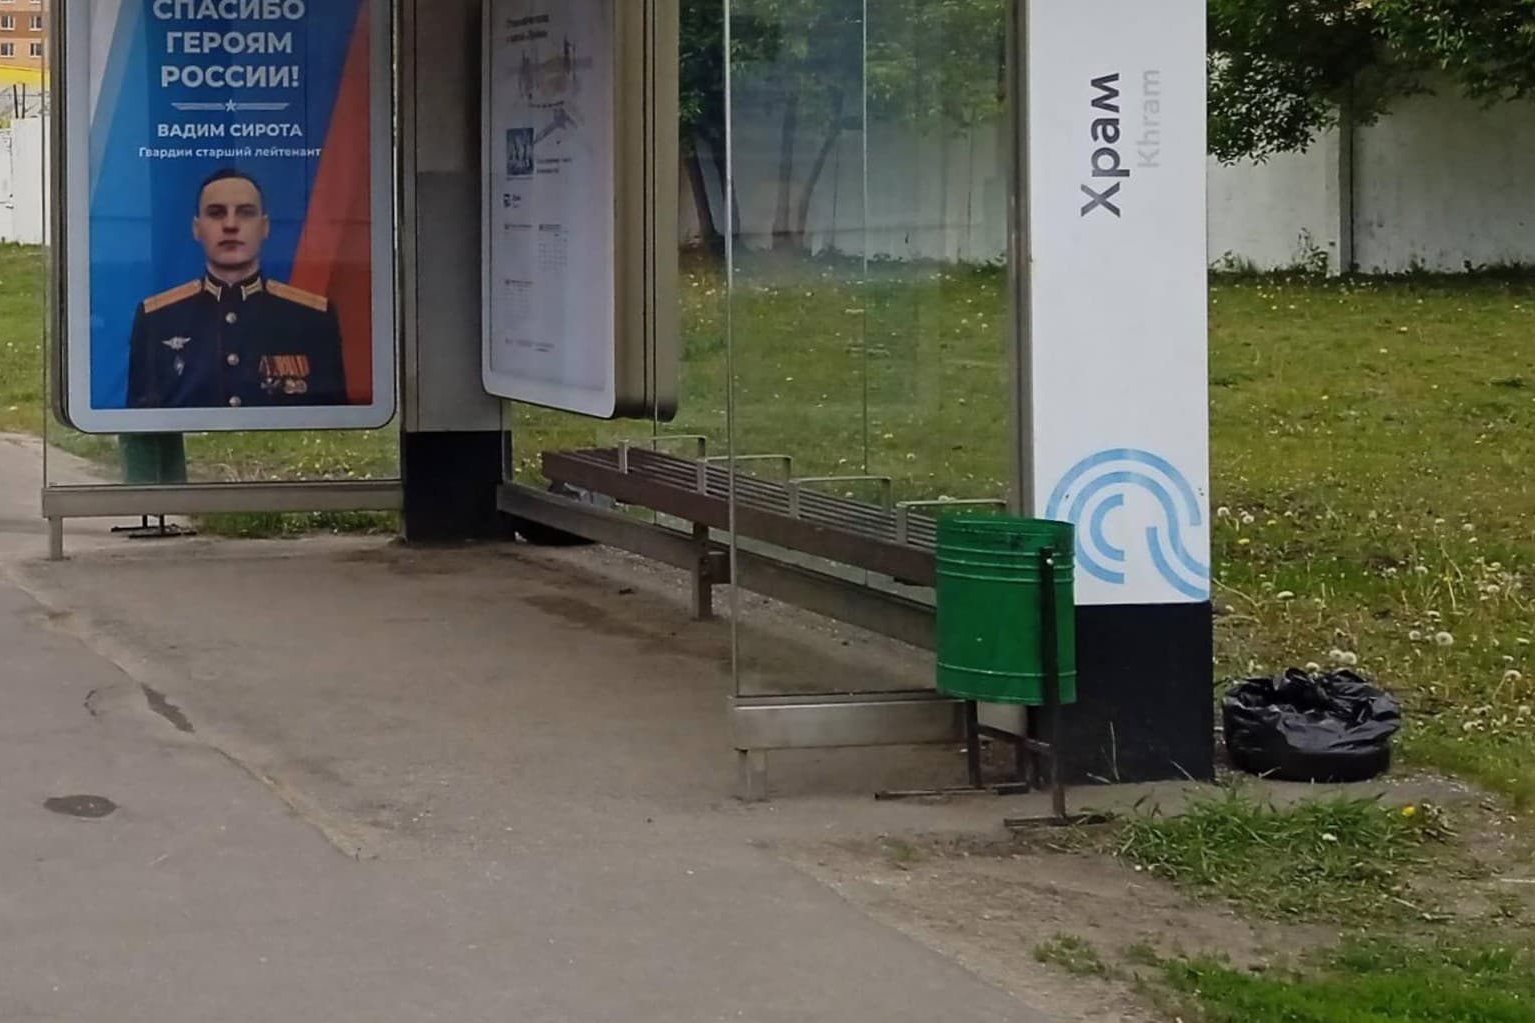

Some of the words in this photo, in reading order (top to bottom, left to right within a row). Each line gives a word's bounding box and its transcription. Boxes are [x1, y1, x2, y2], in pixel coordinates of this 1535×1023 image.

[166, 32, 293, 54] ГЕРОЯМ
[161, 65, 300, 88] РОССИИ!
[1136, 69, 1162, 168] Khram
[157, 123, 225, 139] ВАДИМ
[229, 123, 303, 137] СИРОТА
[138, 146, 193, 159] Гвардии
[196, 146, 252, 159] старший
[254, 146, 322, 158] лейтенант
[1081, 72, 1130, 218] Храм
